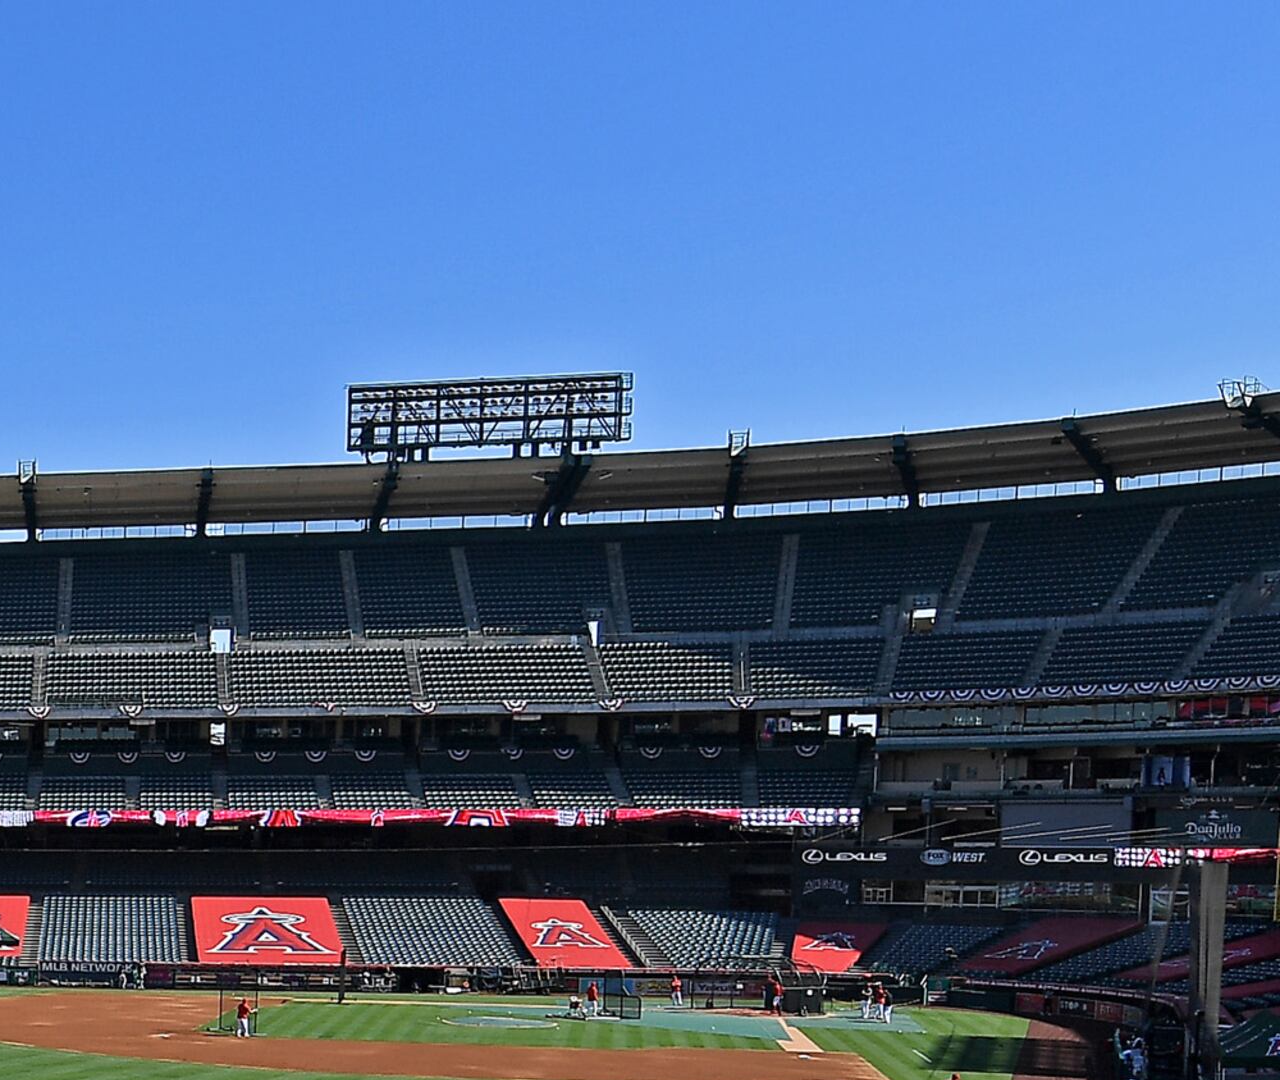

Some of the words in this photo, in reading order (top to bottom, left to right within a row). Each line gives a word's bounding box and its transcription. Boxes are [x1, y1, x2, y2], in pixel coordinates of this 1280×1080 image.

[824, 852, 888, 862] LEXUS
[951, 852, 985, 863] WEST
[1042, 853, 1108, 863] LEXUS
[42, 962, 68, 972] MLB
